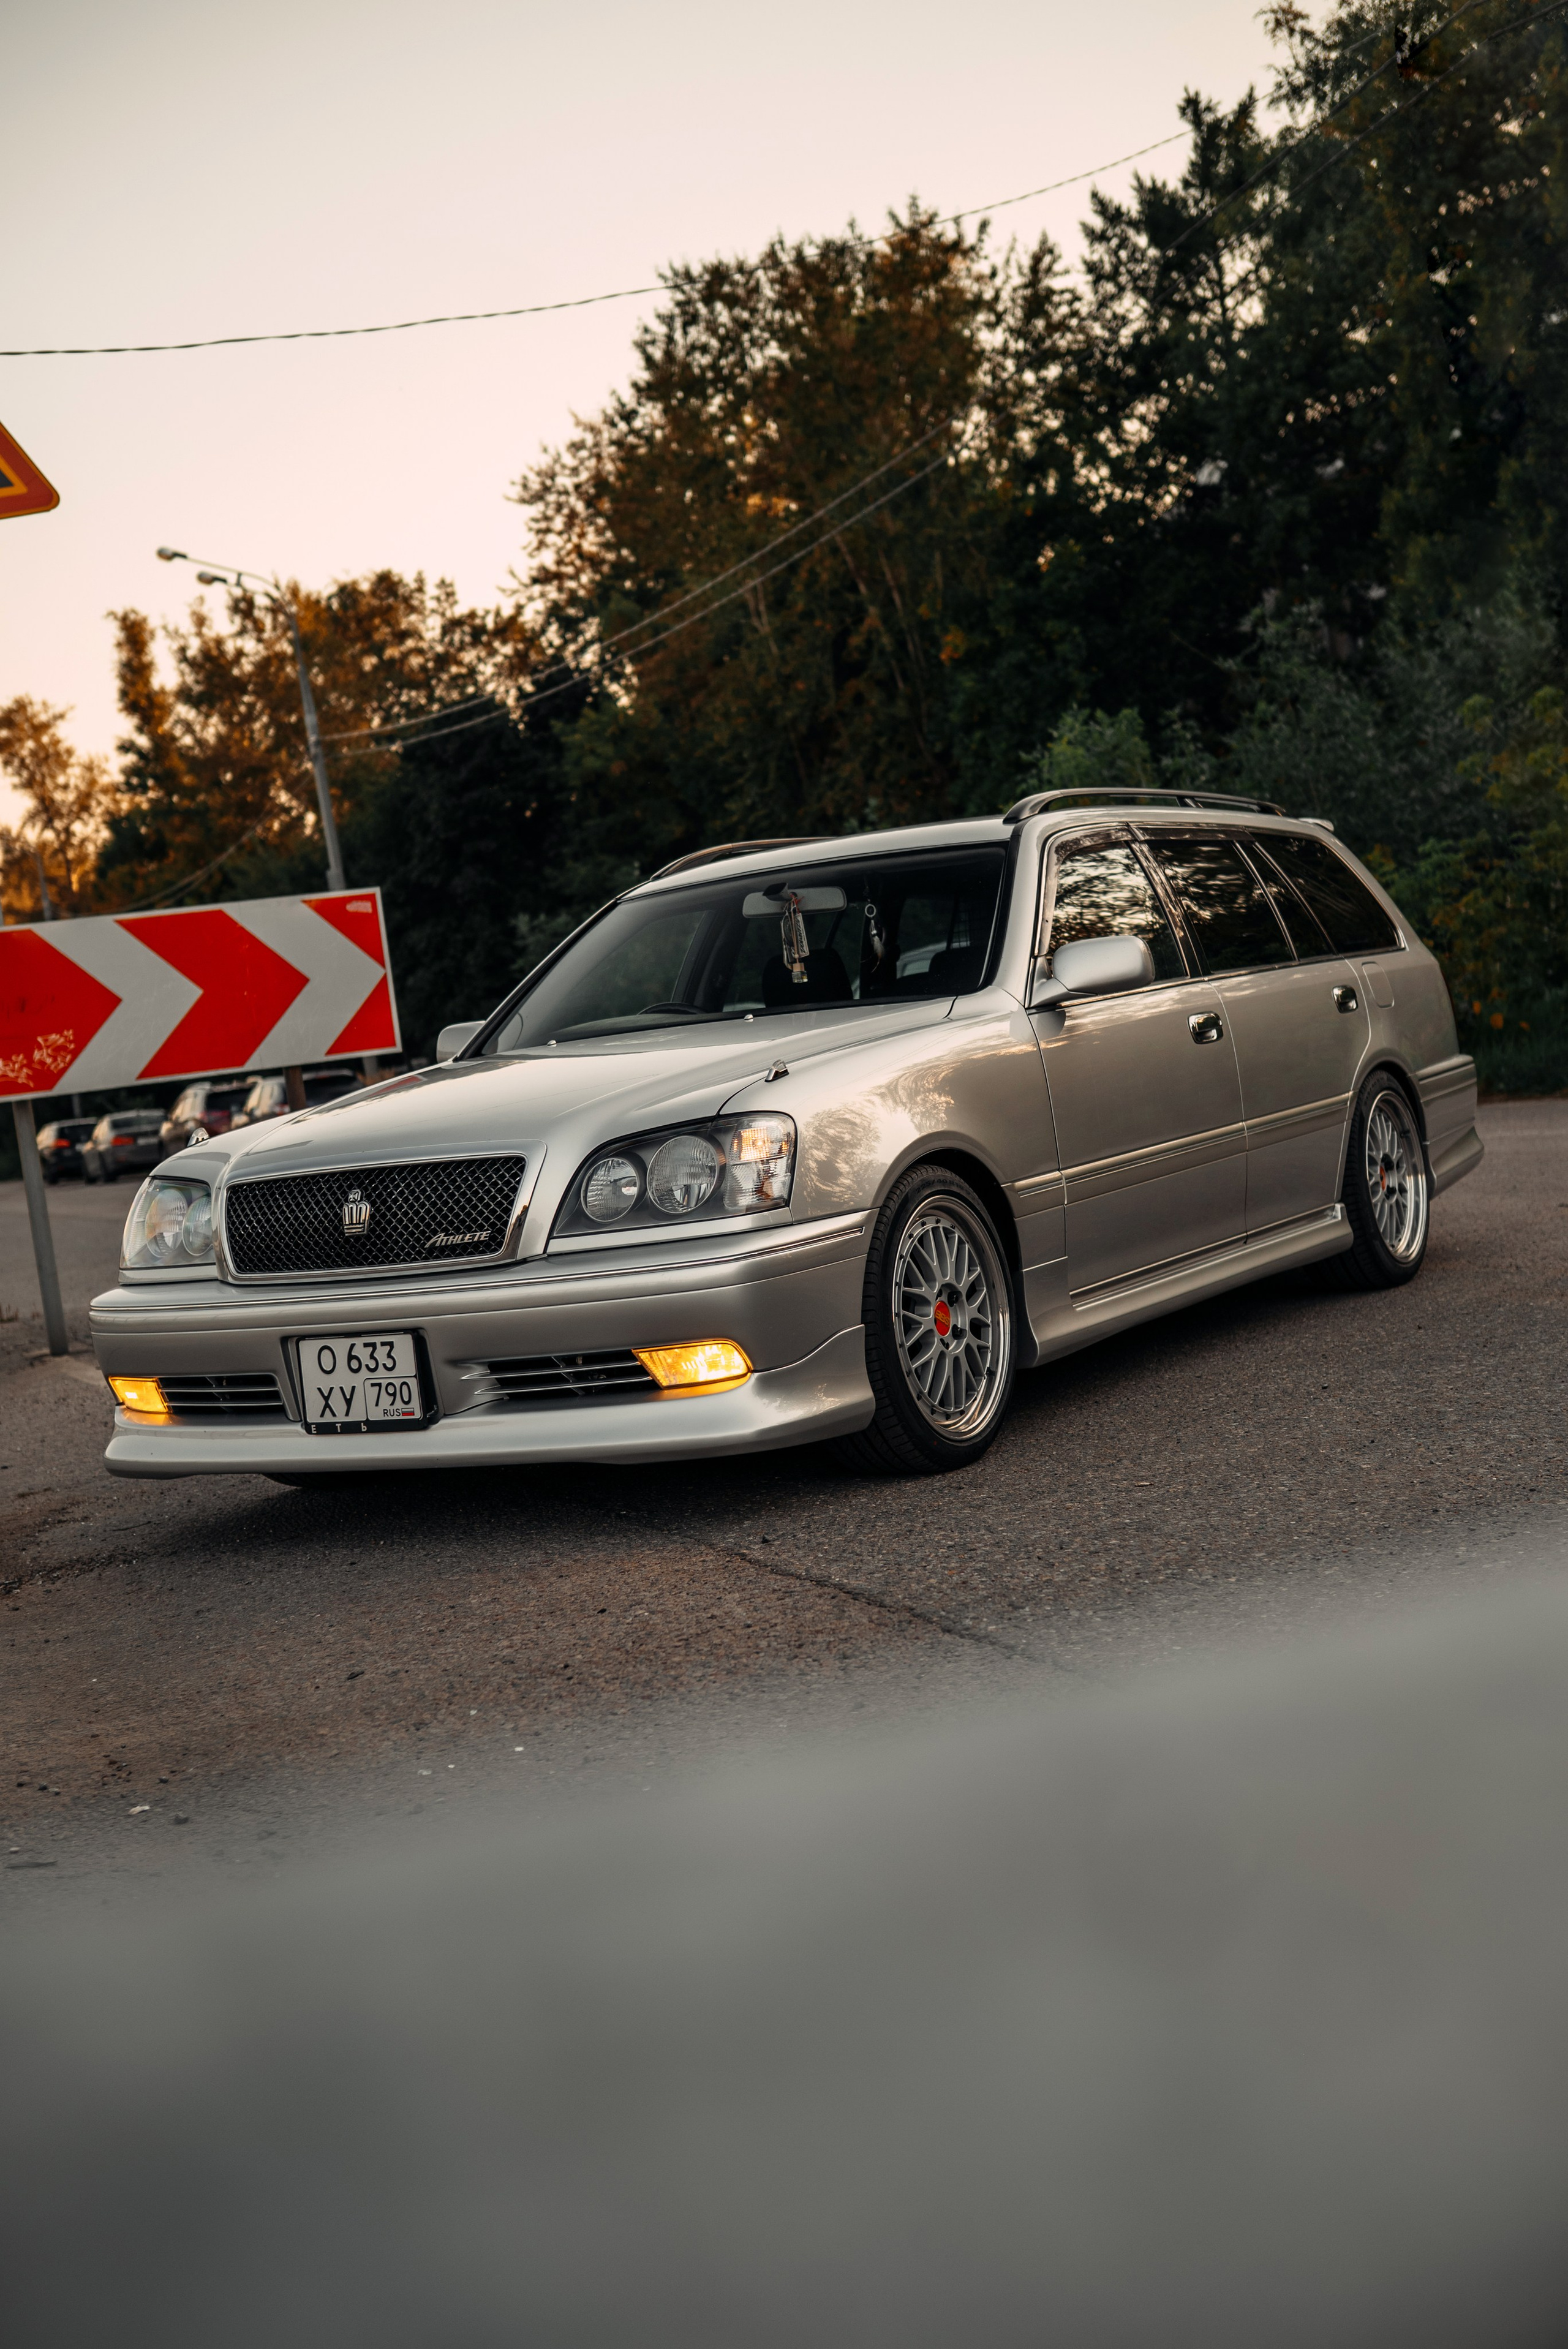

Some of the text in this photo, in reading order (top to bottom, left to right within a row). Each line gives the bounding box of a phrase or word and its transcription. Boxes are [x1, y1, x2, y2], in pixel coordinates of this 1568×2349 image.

[424, 1231, 491, 1248] ATHLETE
[935, 1310, 950, 1327] BBS
[347, 1340, 397, 1374] 633
[370, 1381, 412, 1407] 790
[383, 1408, 401, 1417] RUS
